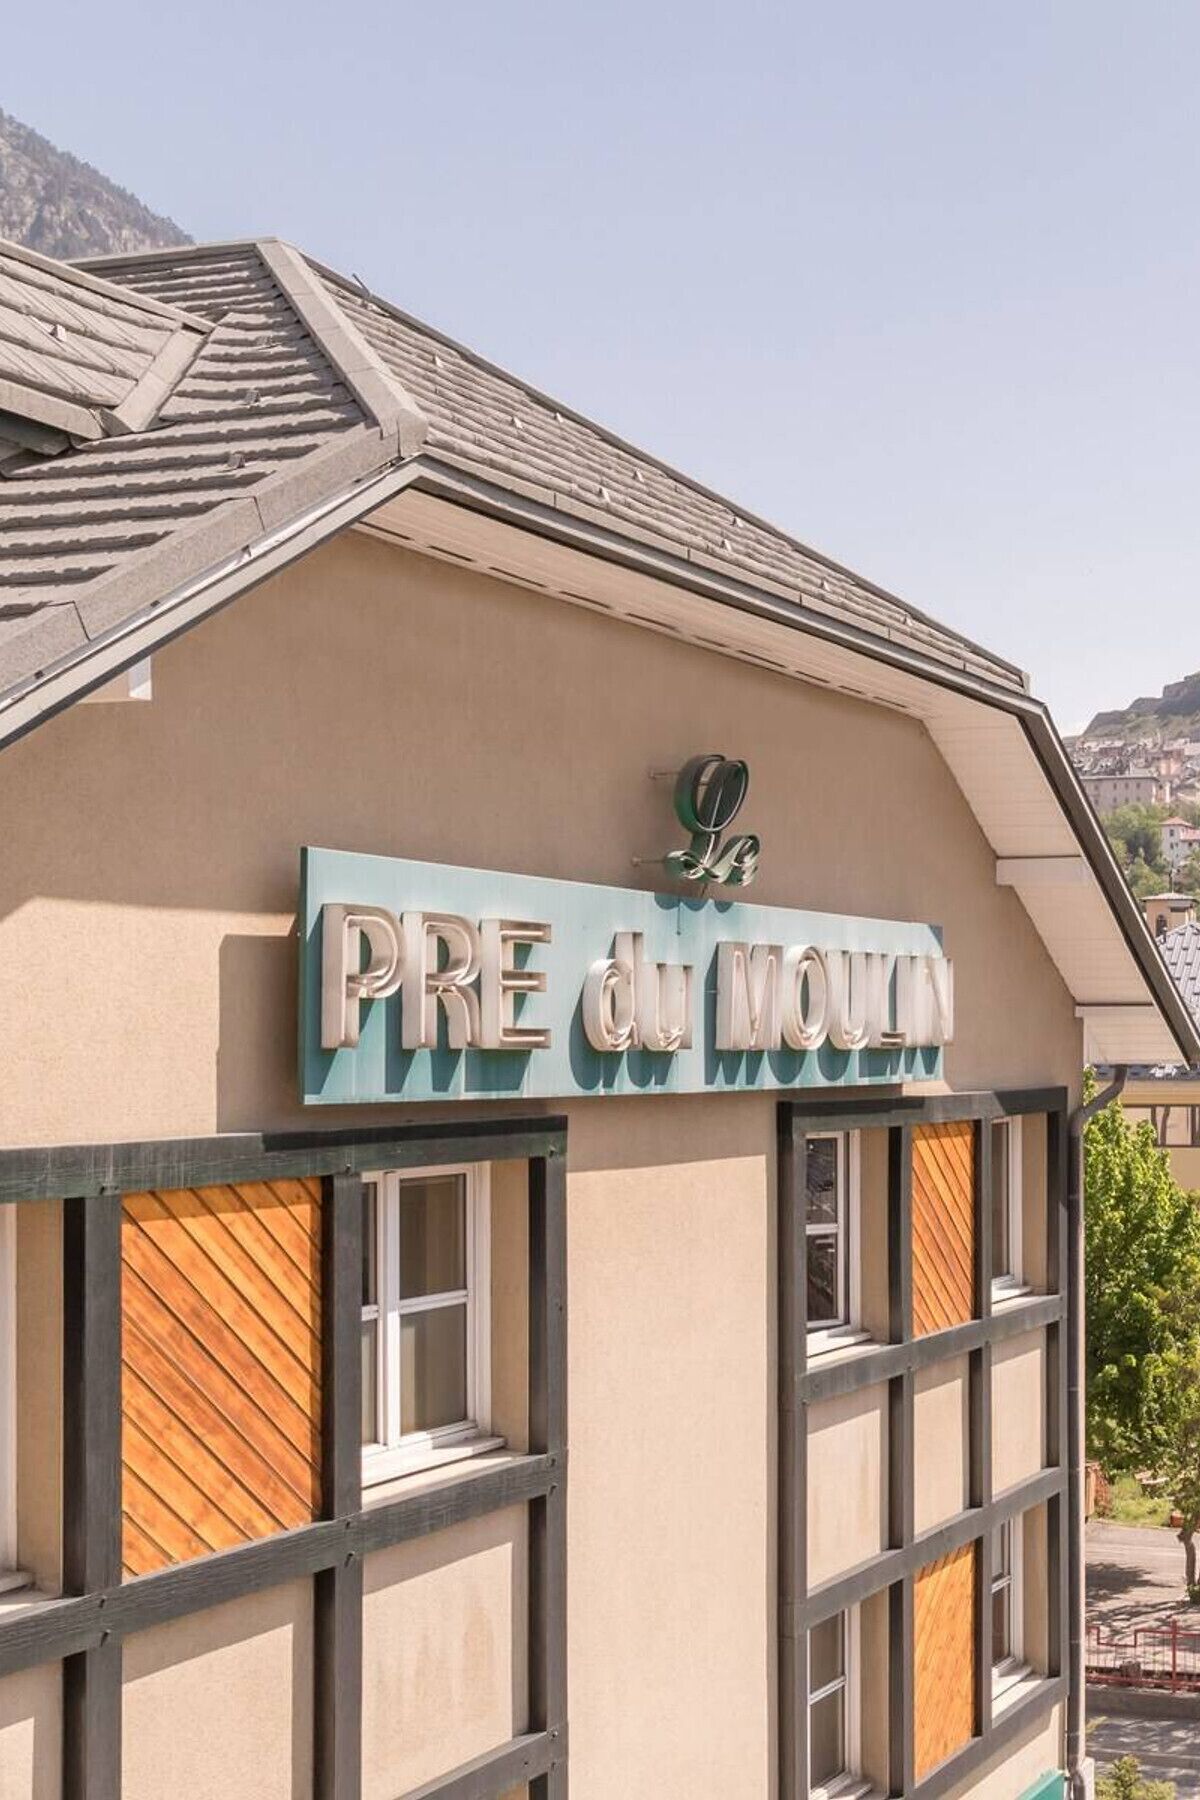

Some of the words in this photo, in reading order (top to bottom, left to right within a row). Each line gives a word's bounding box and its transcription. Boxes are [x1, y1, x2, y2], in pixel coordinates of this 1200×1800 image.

[321, 903, 551, 1049] PRE
[582, 931, 693, 1051] du
[716, 941, 954, 1050] MOULIN
